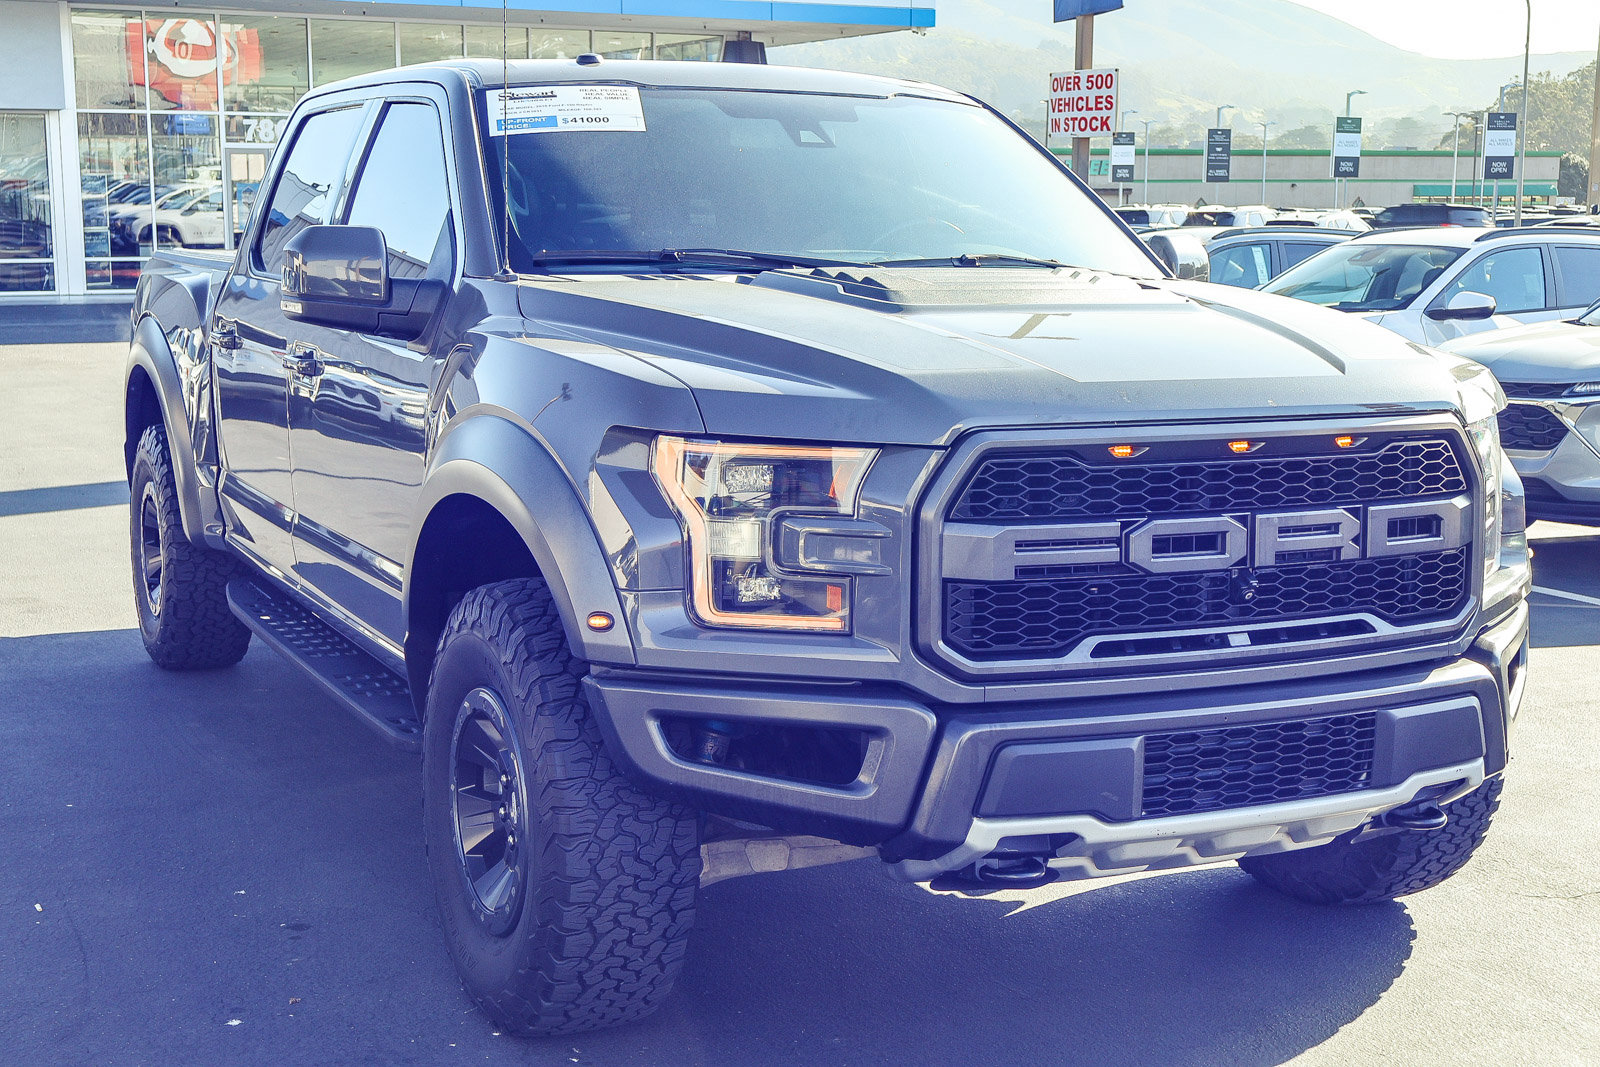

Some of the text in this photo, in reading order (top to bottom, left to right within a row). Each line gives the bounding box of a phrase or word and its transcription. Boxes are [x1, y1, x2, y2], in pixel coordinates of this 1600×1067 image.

[1052, 73, 1114, 93] OVER 500
[1050, 94, 1114, 113] VEHICLES
[1051, 116, 1111, 133] IN STOCK
[943, 498, 1473, 581] FORD
